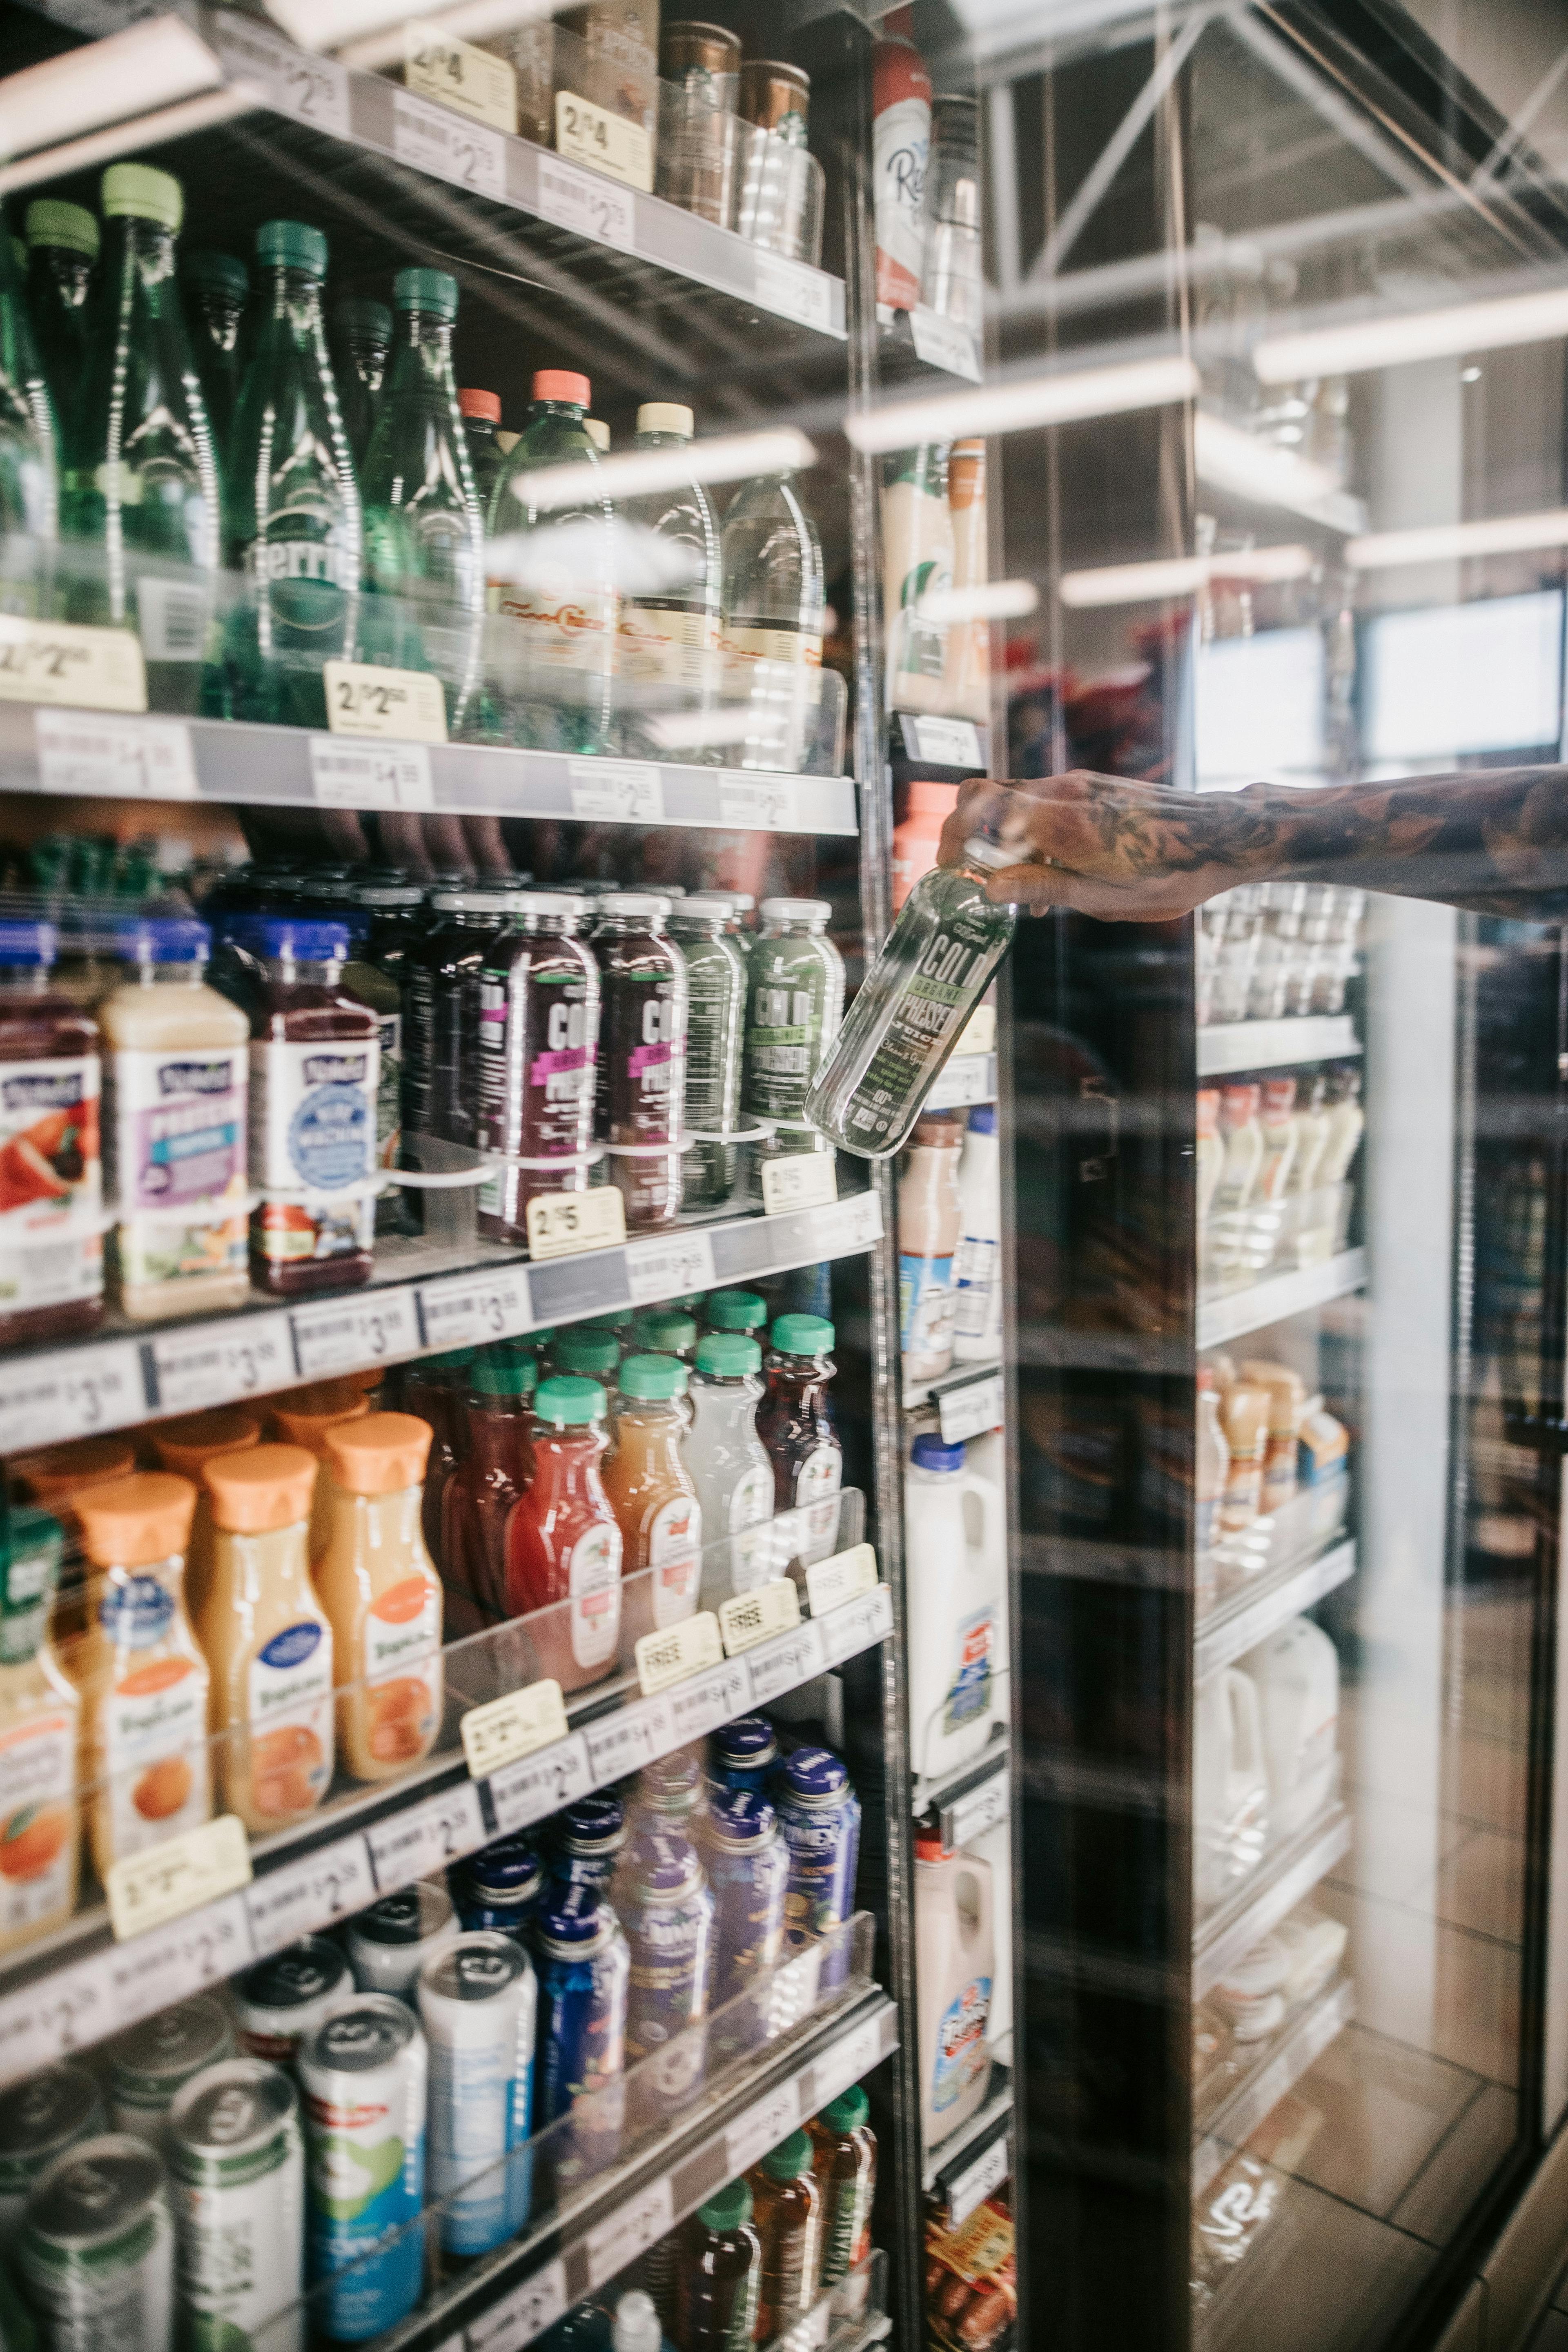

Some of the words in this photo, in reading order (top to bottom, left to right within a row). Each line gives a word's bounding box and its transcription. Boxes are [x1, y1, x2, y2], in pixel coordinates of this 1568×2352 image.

[922, 934, 988, 989] COLD
[899, 993, 958, 1034] PRESSED
[891, 1020, 944, 1046] JUICE
[872, 1088, 893, 1105] 100%
